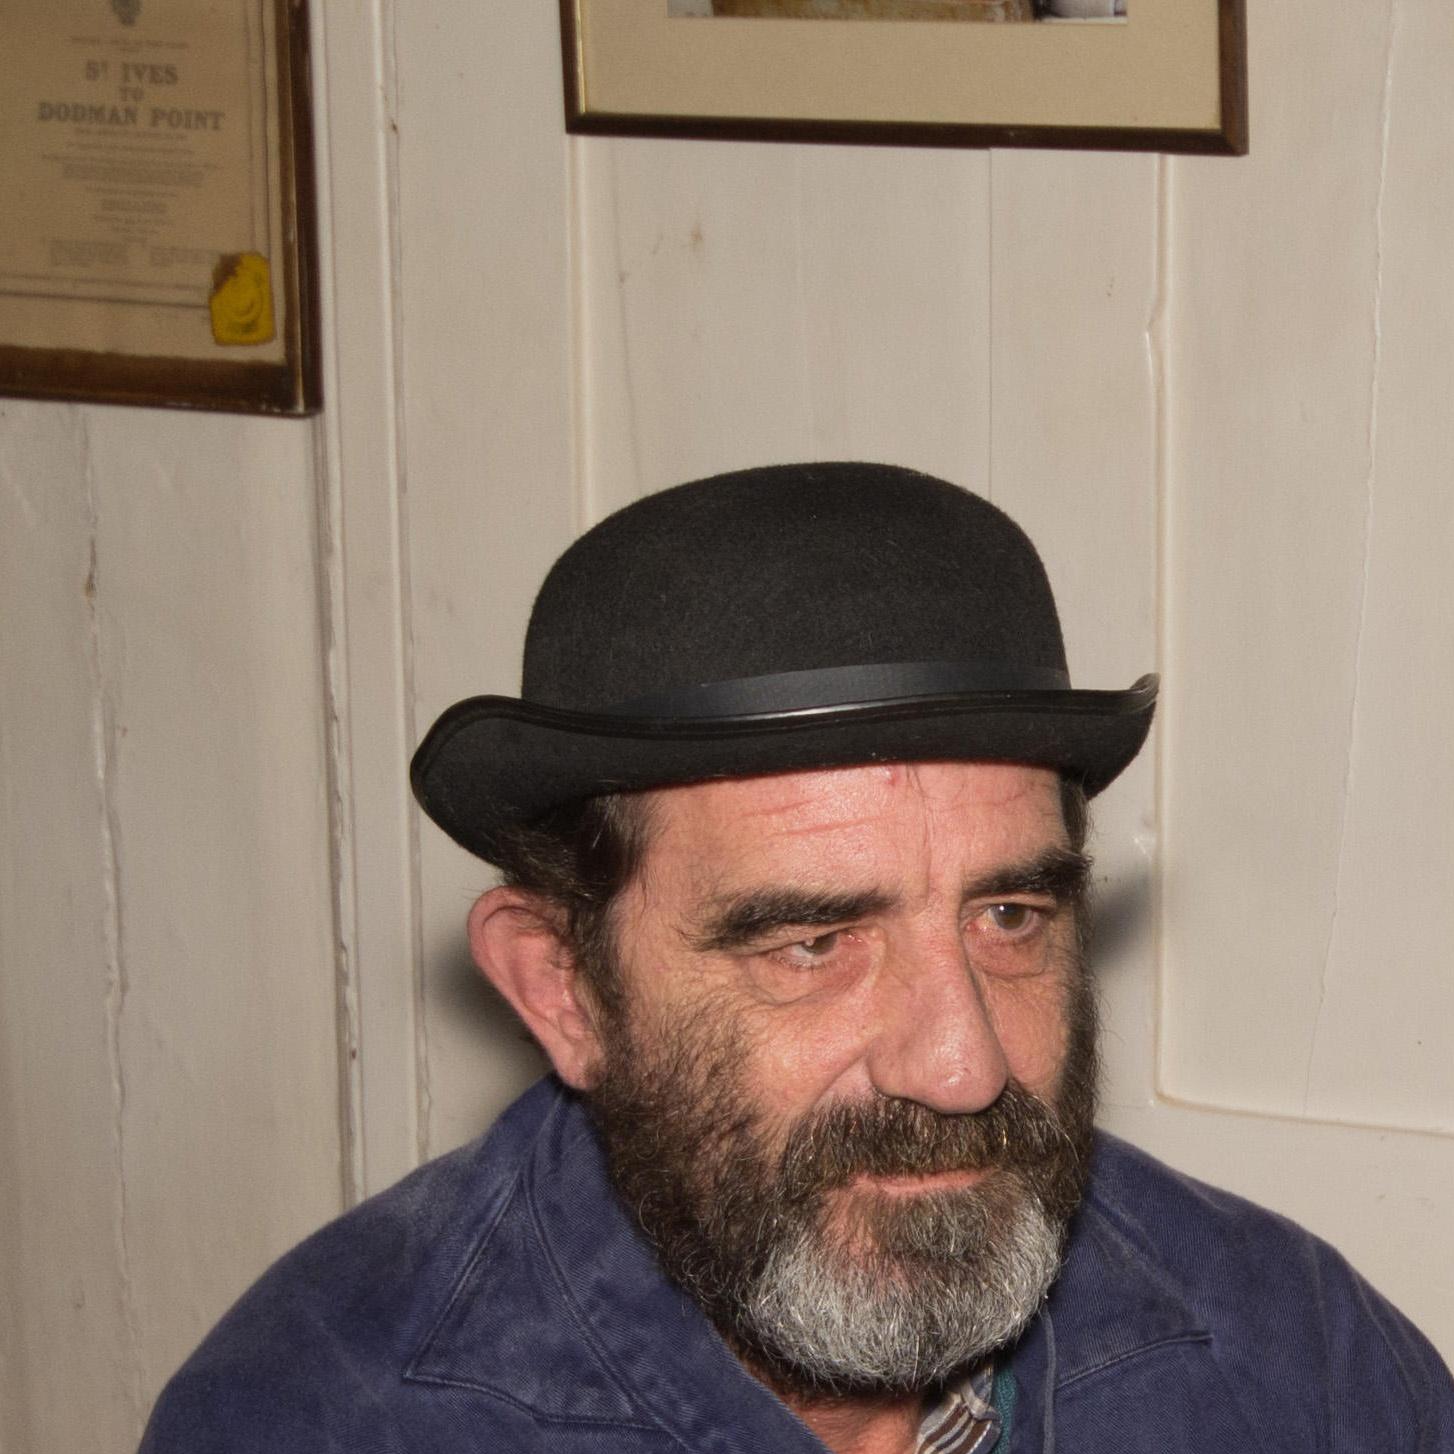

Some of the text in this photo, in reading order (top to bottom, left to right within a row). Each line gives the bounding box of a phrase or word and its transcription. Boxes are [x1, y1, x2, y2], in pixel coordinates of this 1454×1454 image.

[121, 62, 178, 84] IVES
[119, 87, 144, 101] TO
[38, 102, 225, 130] DODMAN POINT
